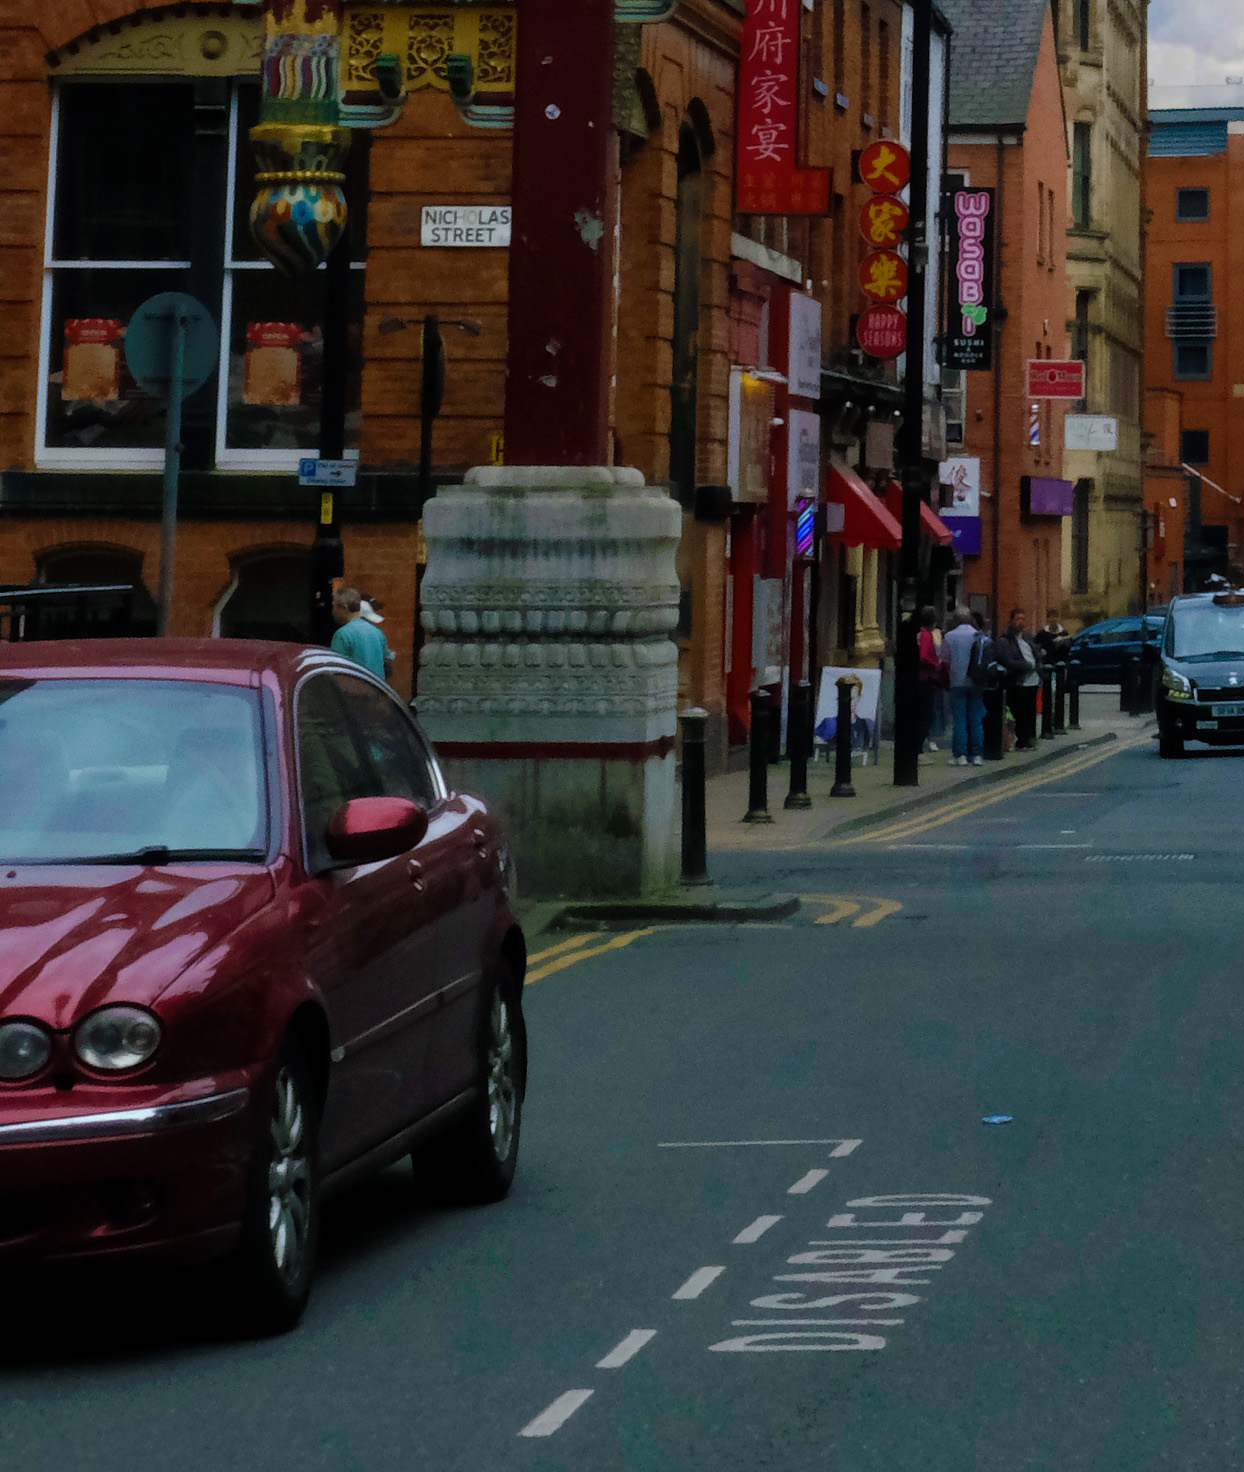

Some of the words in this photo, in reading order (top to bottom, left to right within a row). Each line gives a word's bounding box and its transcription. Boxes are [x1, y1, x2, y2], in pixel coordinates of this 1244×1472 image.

[431, 227, 496, 243] STREET
[869, 313, 899, 329] HAPPY
[708, 1193, 993, 1352] DISABLED
